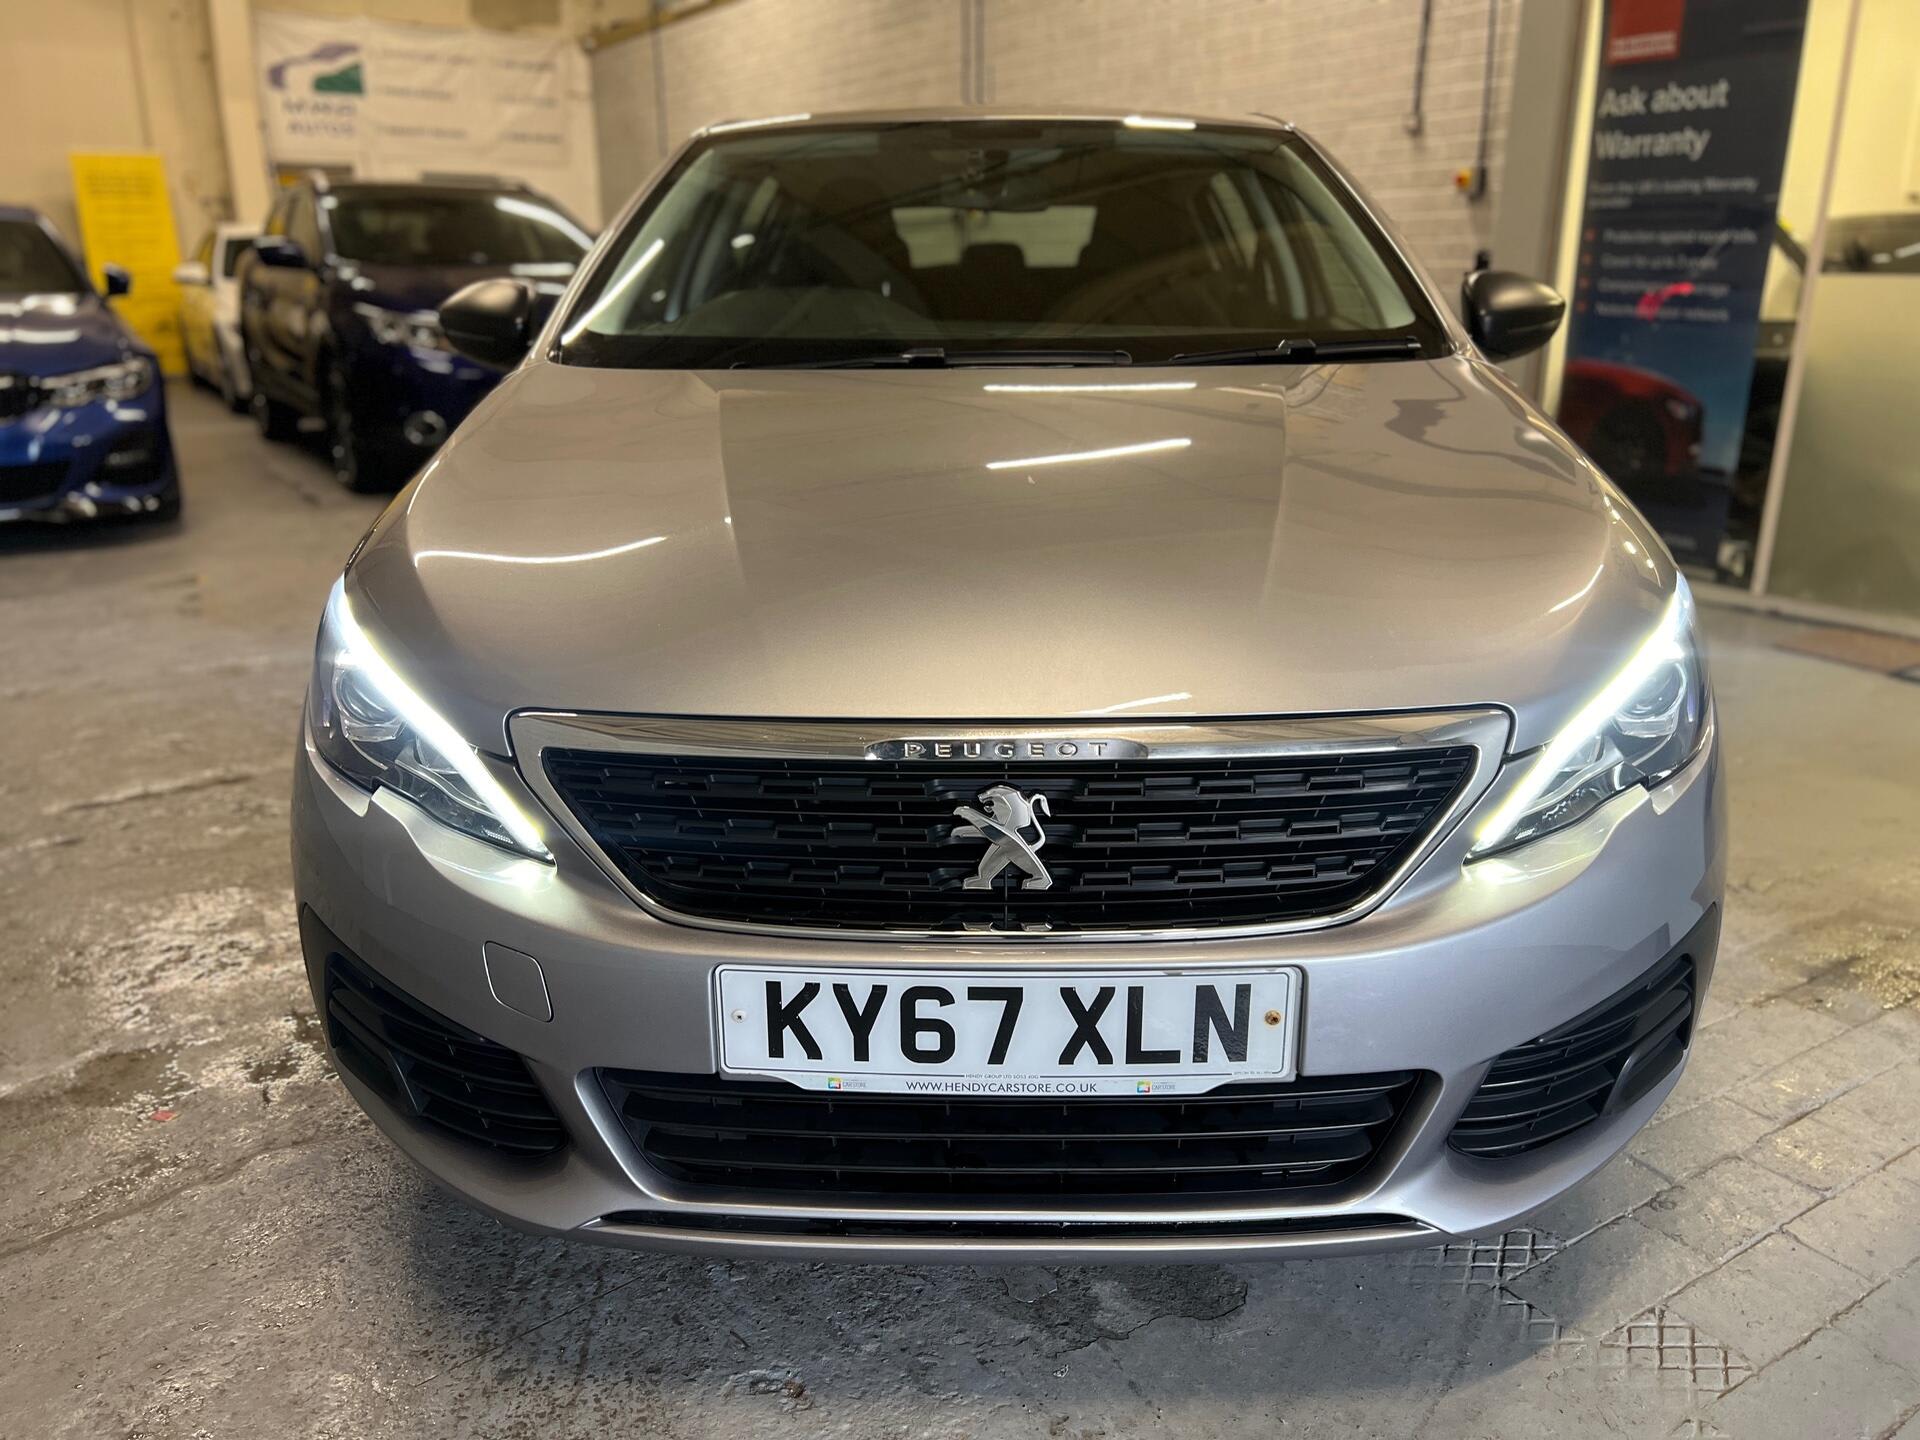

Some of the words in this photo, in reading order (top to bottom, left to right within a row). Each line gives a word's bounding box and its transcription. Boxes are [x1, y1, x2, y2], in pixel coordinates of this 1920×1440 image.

[1599, 86, 1647, 119] Ask
[1651, 78, 1730, 114] about
[1595, 126, 1711, 161] Warranty
[903, 742, 1108, 759] PEUGEOT
[764, 981, 1024, 1065] KY67
[1057, 983, 1253, 1065] XLN
[906, 1081, 1098, 1094] WWW.HENDYCARSTORE.CO.UK
